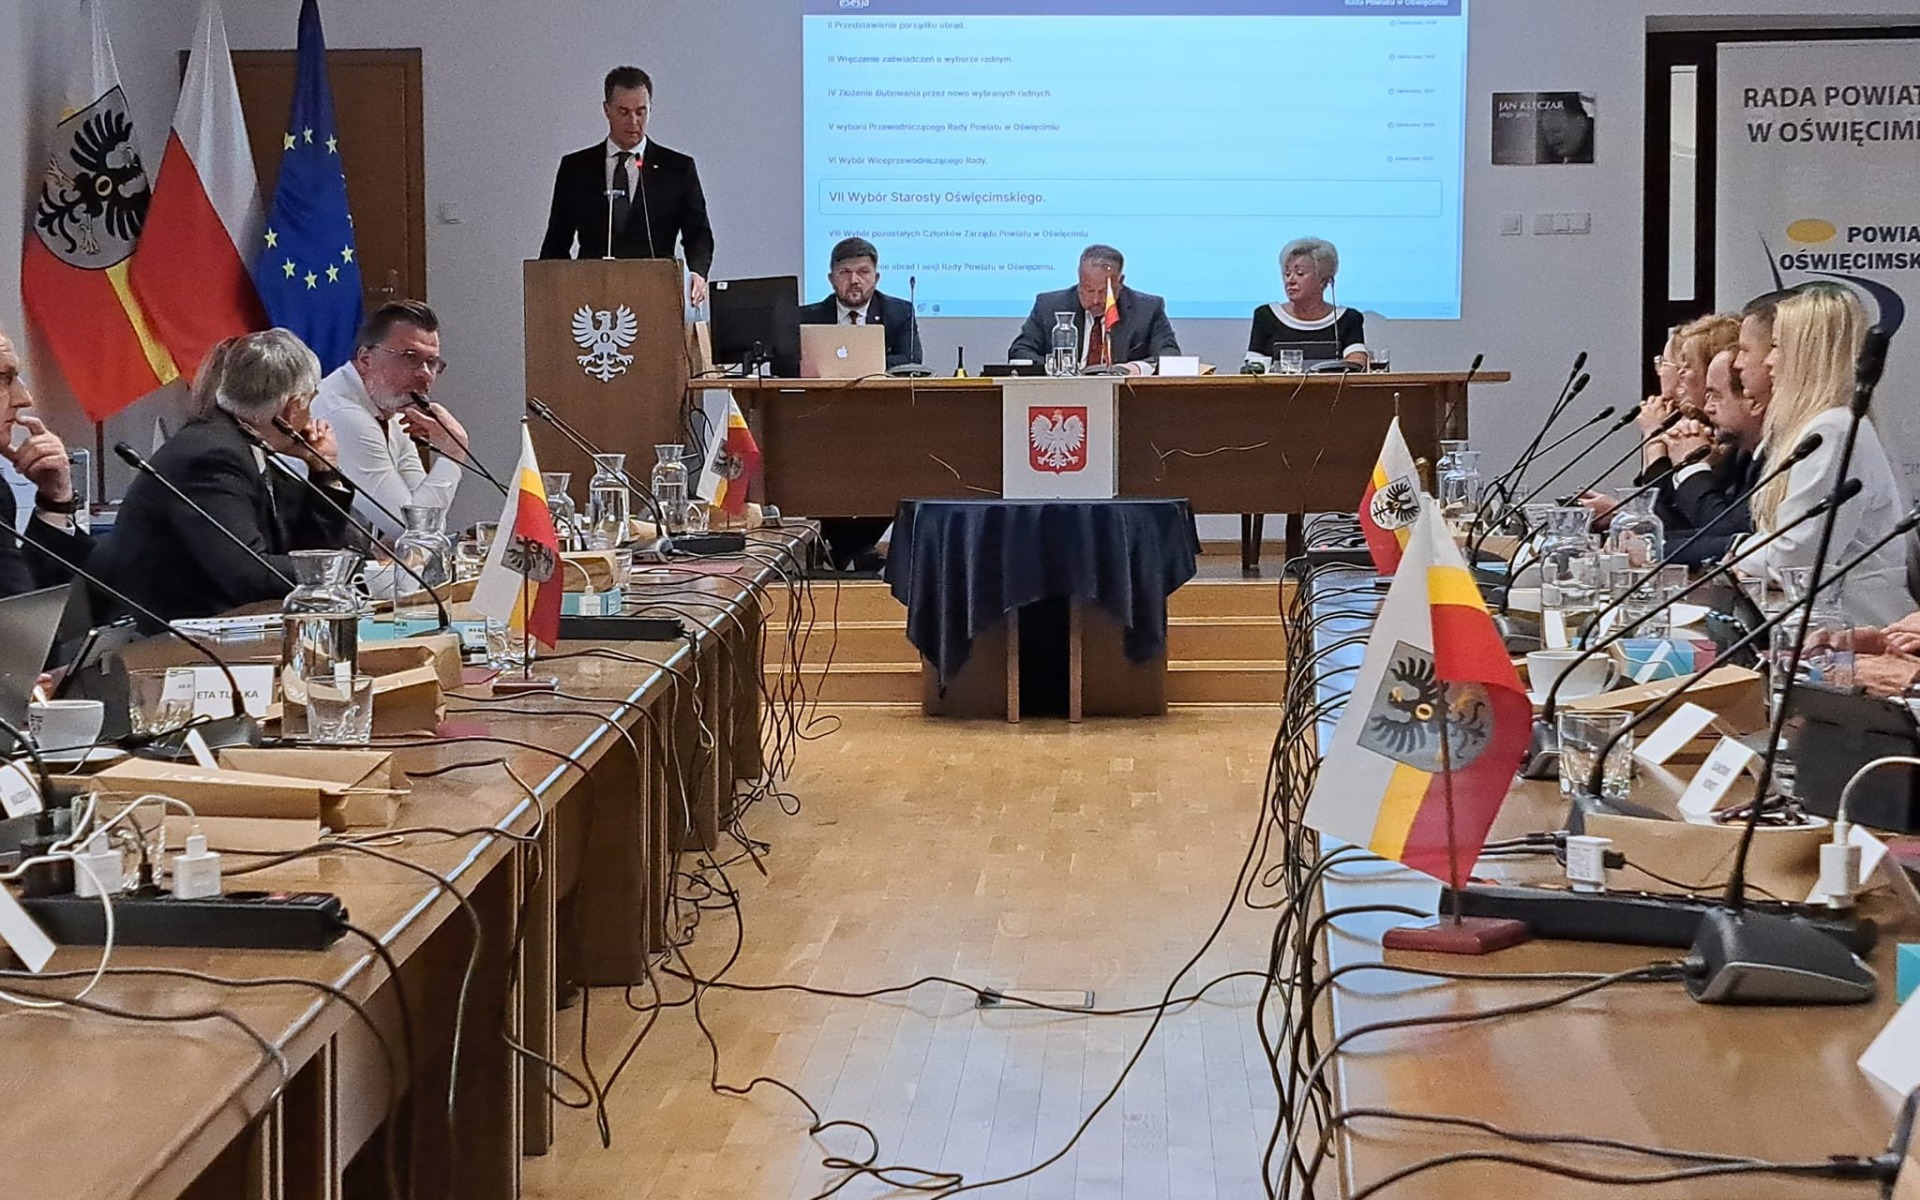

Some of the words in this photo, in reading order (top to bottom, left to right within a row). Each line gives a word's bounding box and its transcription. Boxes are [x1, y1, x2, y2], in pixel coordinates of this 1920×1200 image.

[1743, 87, 1817, 108] RADA
[1747, 121, 1773, 143] W
[829, 191, 844, 202] VII
[847, 191, 887, 205] Wybór
[890, 191, 941, 205] Starosty
[944, 190, 1046, 205] Oświęcimskiego.
